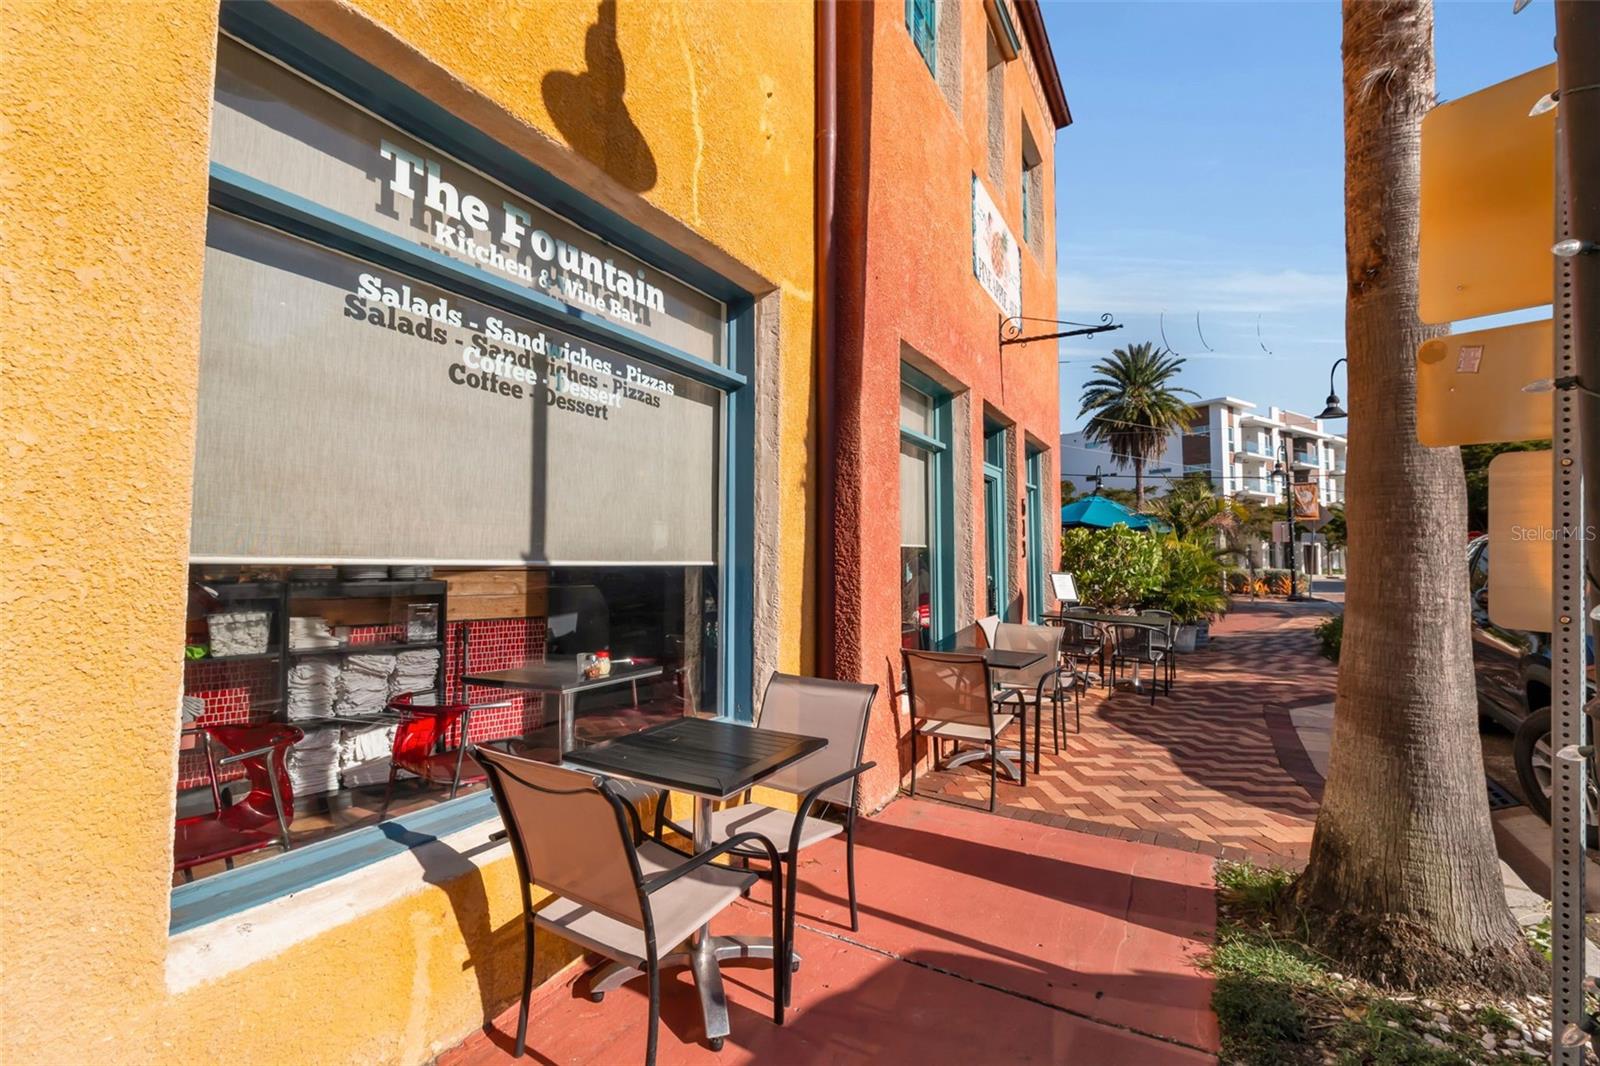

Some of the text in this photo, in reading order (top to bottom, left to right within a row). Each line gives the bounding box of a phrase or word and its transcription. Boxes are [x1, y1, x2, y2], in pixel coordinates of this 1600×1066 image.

[380, 138, 666, 314] The Fountain
[434, 220, 641, 325] Kitchen & Wine Bar
[357, 273, 463, 328] Salads
[485, 316, 612, 376] Sandwiches
[626, 364, 675, 396] Pizzas
[463, 345, 537, 385] Coffee
[555, 370, 624, 409] Dessert
